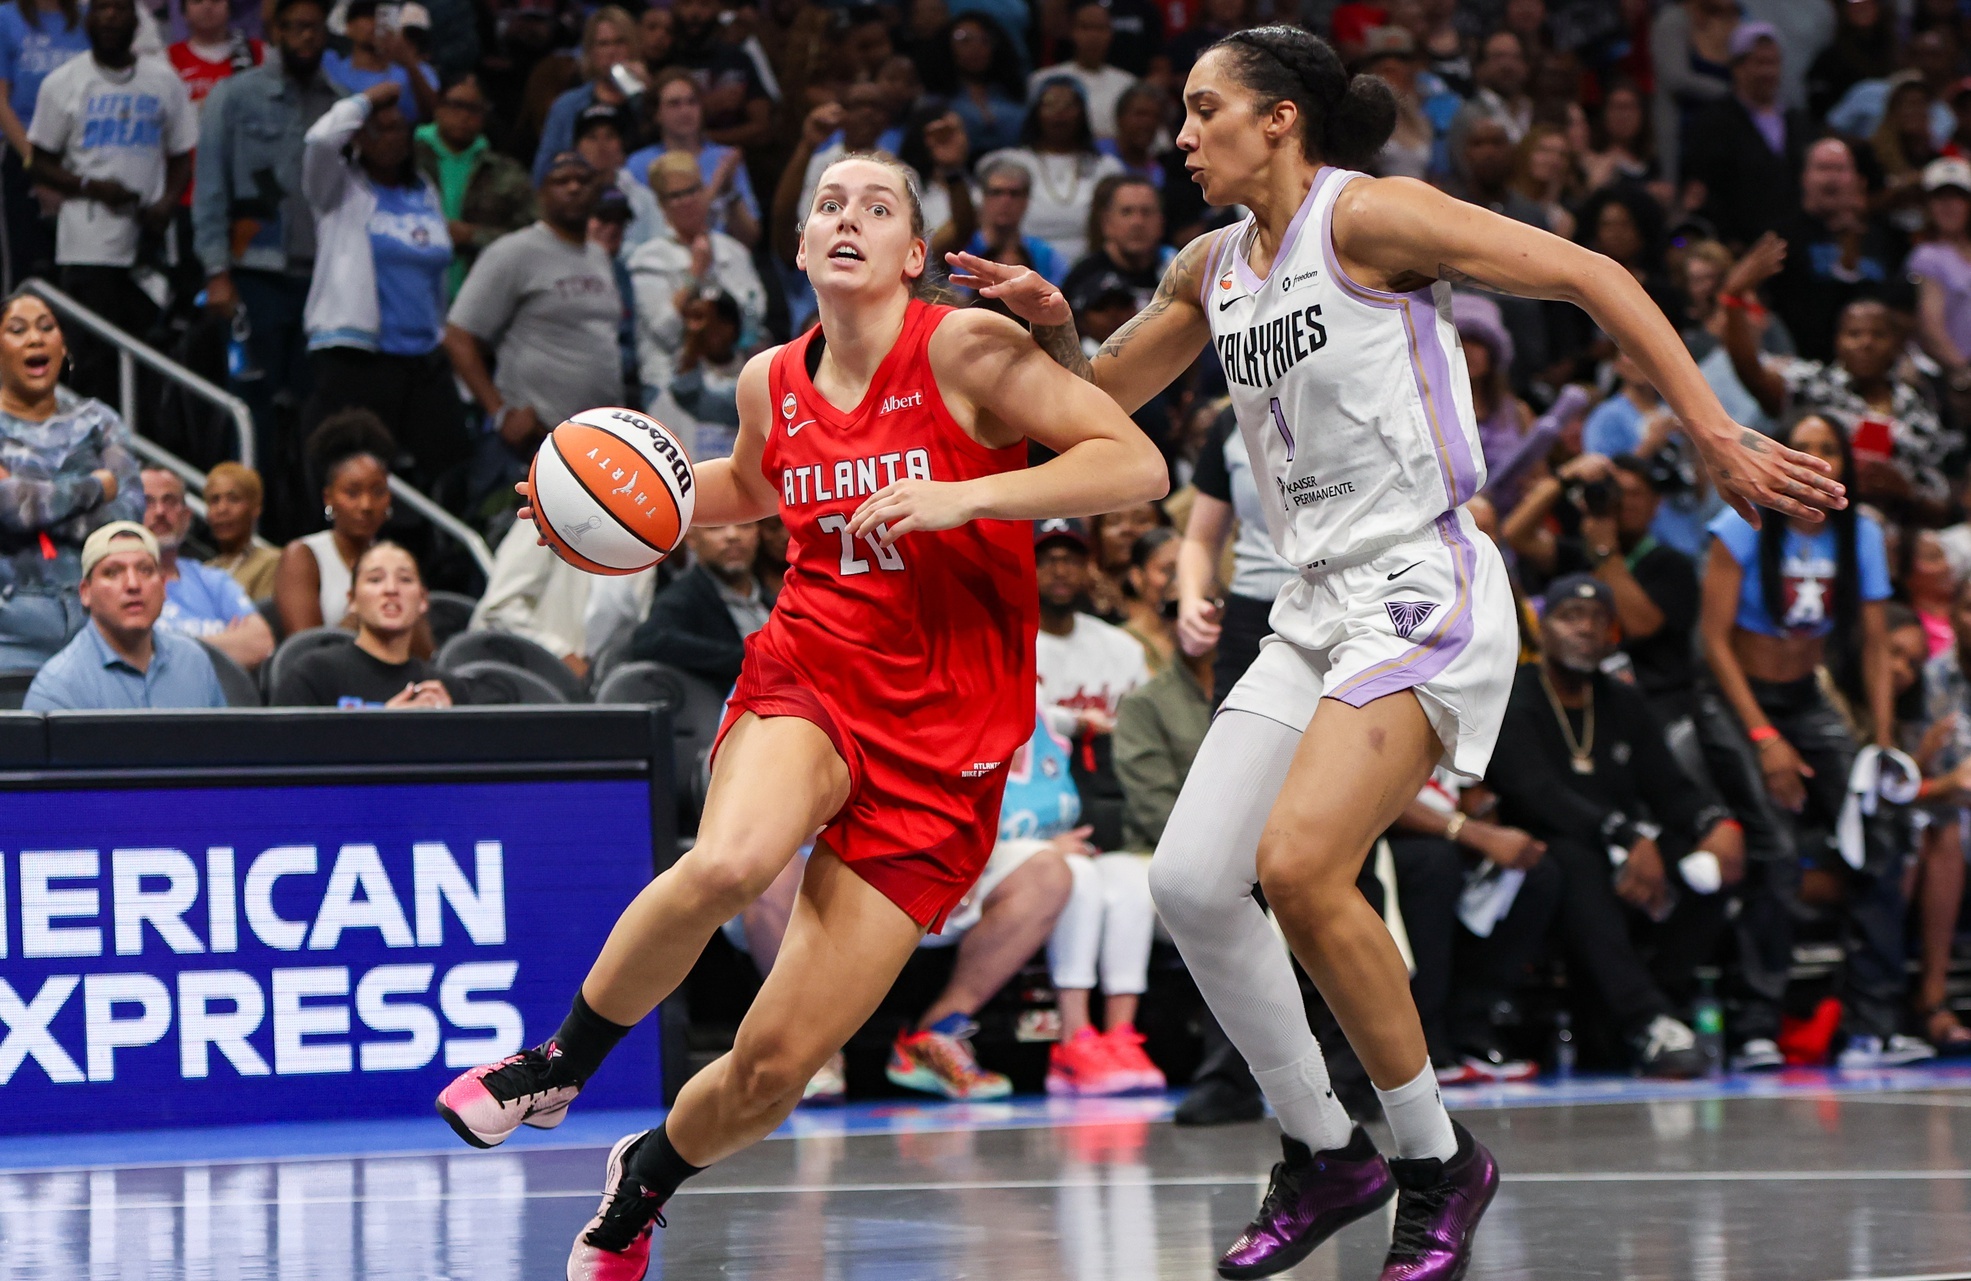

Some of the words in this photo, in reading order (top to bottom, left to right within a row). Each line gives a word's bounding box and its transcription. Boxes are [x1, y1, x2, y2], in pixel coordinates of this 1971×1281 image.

[1292, 270, 1318, 287] freedom
[880, 391, 922, 414] Albert
[1270, 396, 1295, 462] 1
[611, 410, 692, 499] Wilson
[783, 446, 932, 506] ATLANTA
[1286, 475, 1318, 494] KAISER
[1293, 481, 1356, 506] PERMANENTE
[0, 840, 506, 959] ERICAN
